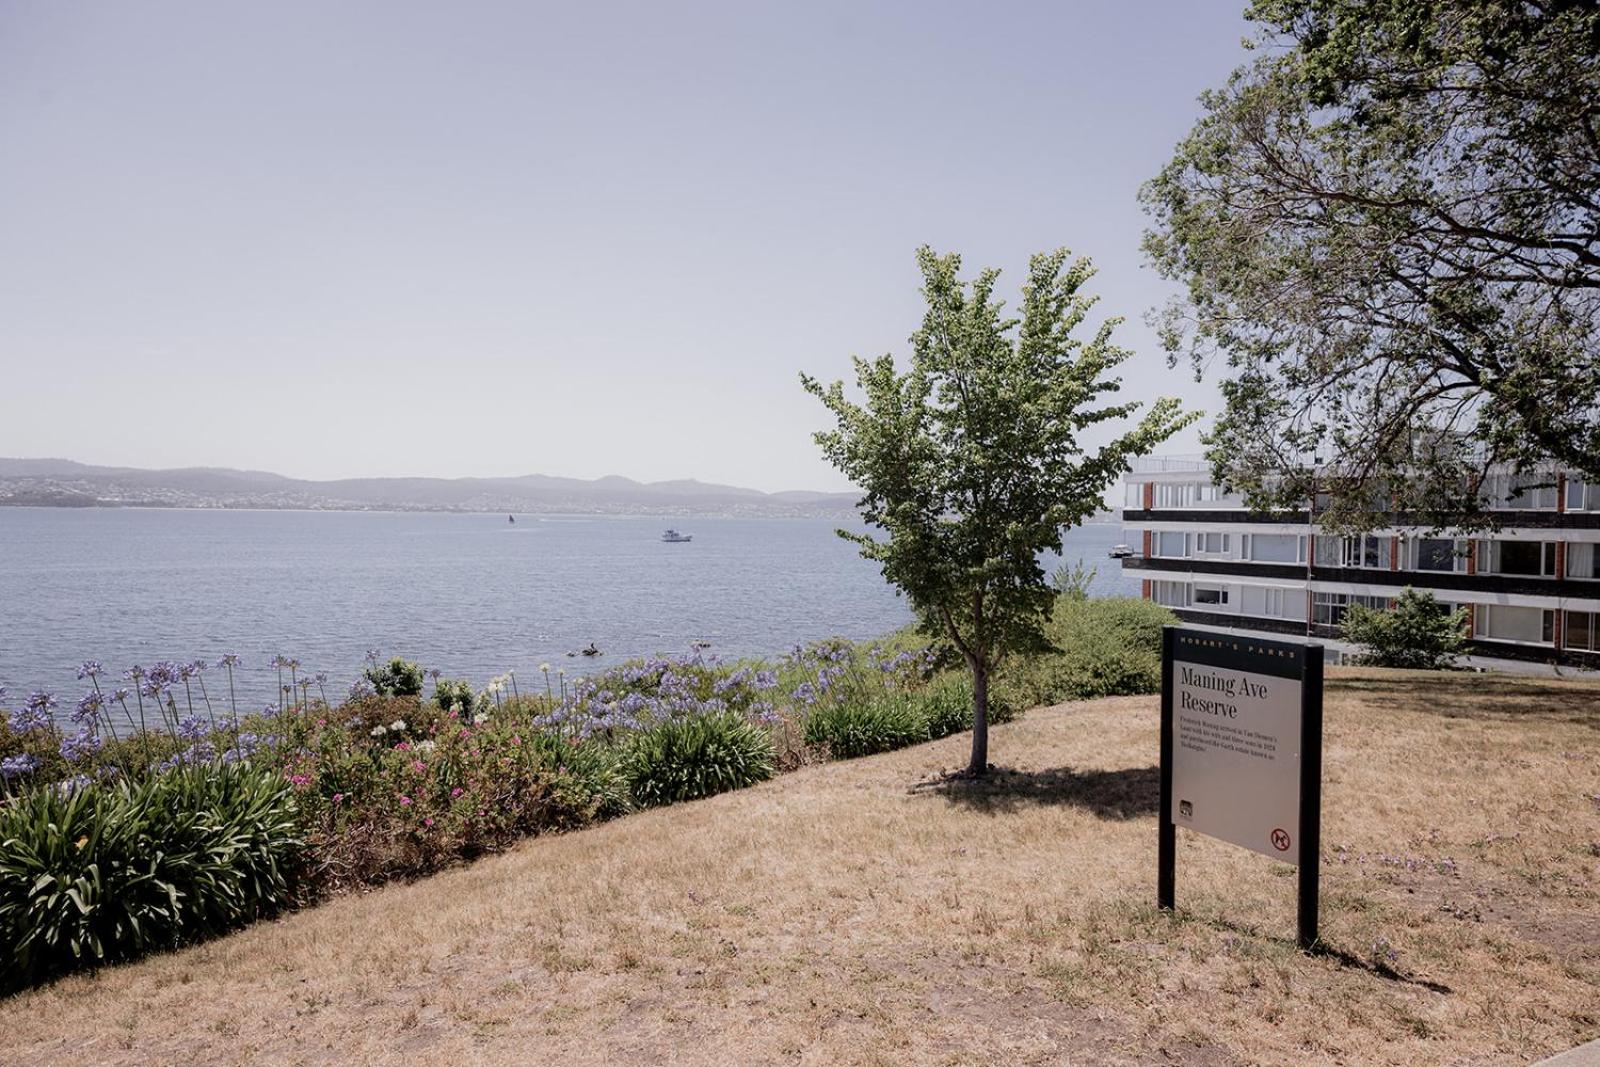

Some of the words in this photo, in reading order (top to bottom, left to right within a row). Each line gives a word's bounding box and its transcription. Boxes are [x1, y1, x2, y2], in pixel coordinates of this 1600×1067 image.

[1180, 636, 1239, 651] HOBART'S
[1248, 645, 1296, 659] PARKS
[1181, 667, 1236, 697] Maning
[1239, 677, 1268, 700] Ave
[1181, 691, 1238, 719] Reserve
